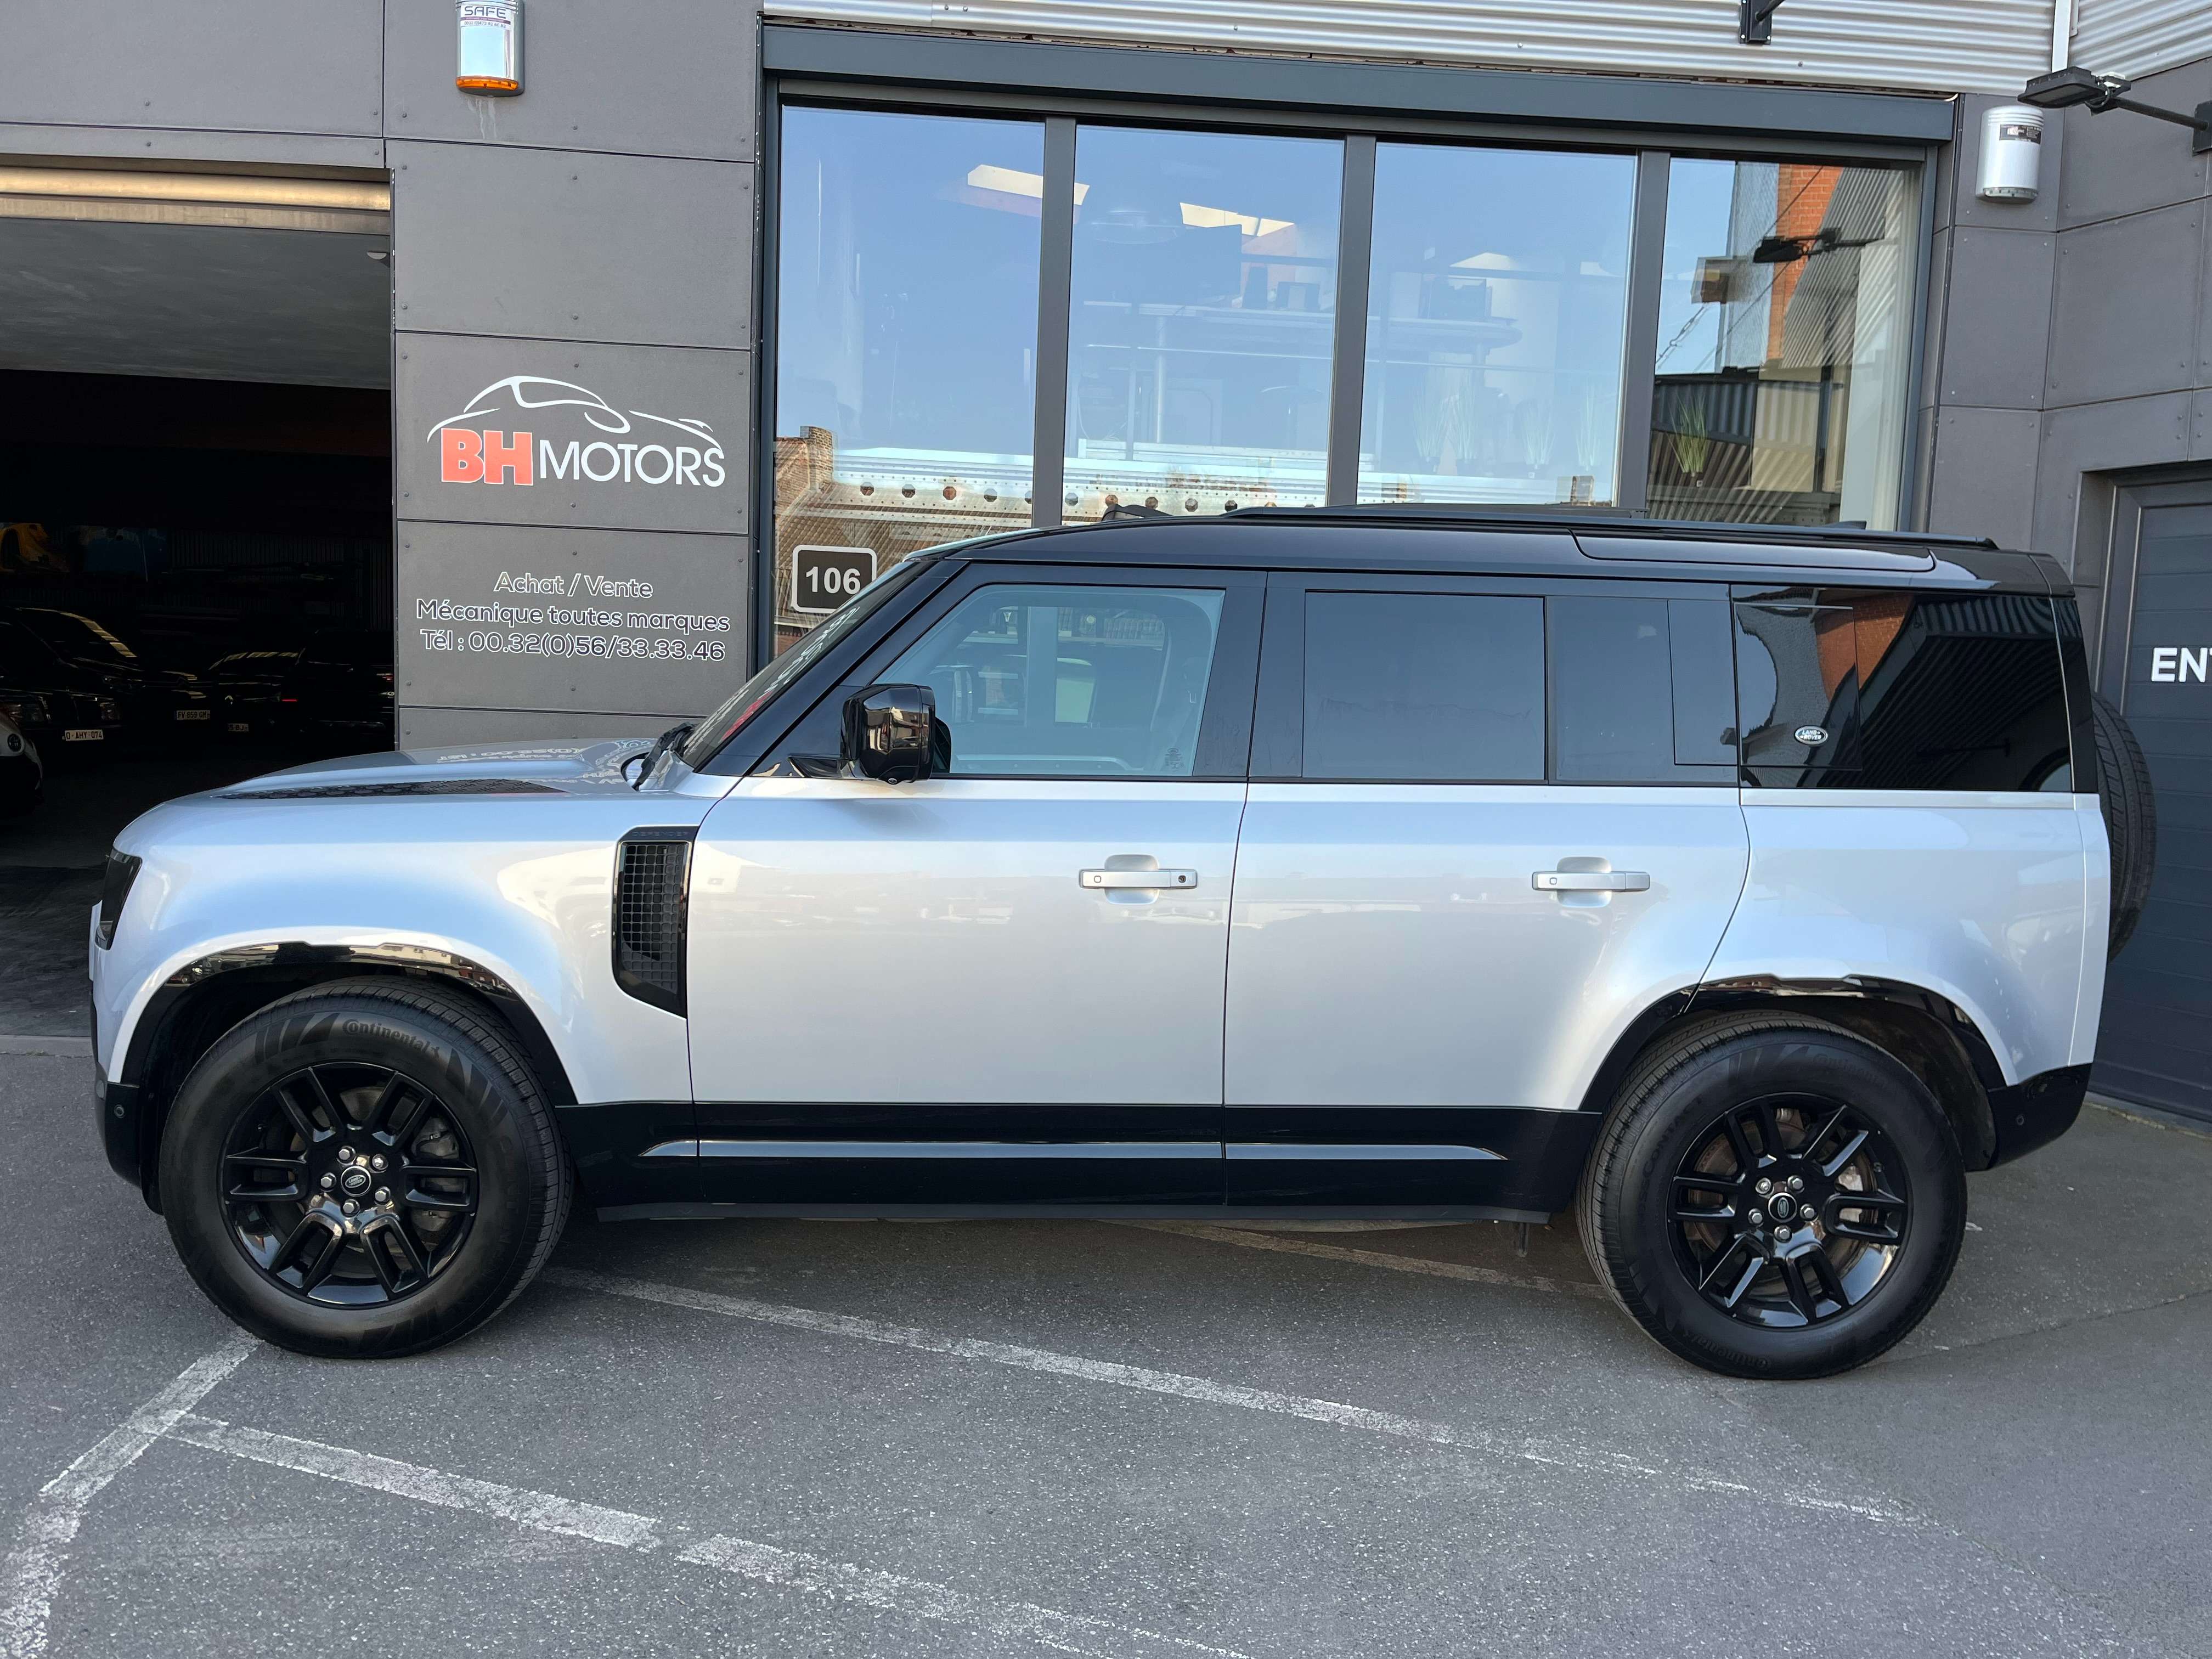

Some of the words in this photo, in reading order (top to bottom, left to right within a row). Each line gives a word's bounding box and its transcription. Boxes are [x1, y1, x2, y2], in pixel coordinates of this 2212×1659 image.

[464, 6, 506, 19] SAFE
[441, 428, 533, 486] BH
[539, 439, 725, 487] MOTORS
[493, 572, 565, 594] Achat
[584, 575, 653, 598] Vente
[805, 566, 861, 594] 106
[416, 599, 543, 628] Mécanique
[547, 606, 623, 627] toutes
[627, 612, 731, 635] marques
[420, 629, 453, 651] Tél
[469, 631, 725, 662] 00.32(0)56/33.33.46
[2151, 647, 2212, 683] EN
[342, 1018, 431, 1054] Continental
